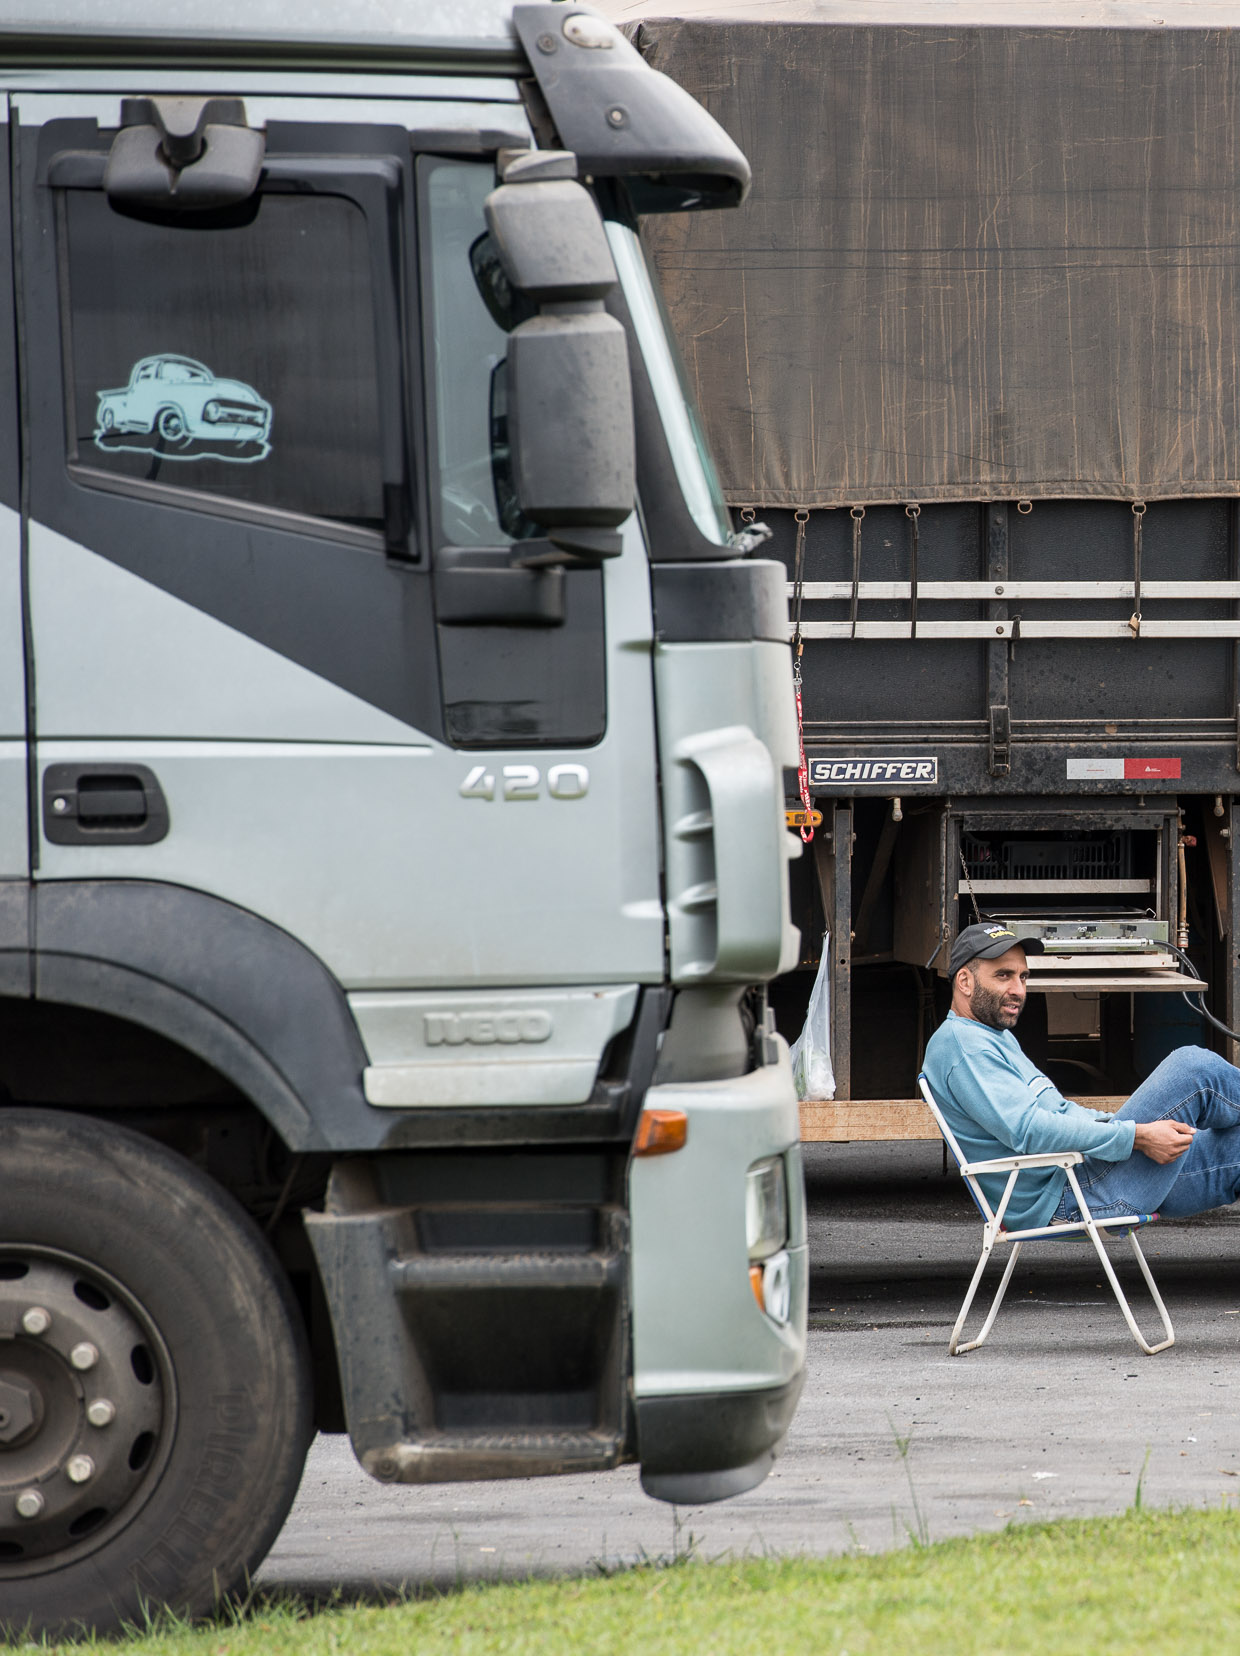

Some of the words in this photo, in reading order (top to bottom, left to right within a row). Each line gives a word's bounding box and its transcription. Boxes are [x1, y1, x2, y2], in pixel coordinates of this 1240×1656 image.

[459, 763, 589, 801] 420
[814, 763, 932, 780] SCHIFFER
[424, 1009, 552, 1046] IVECO
